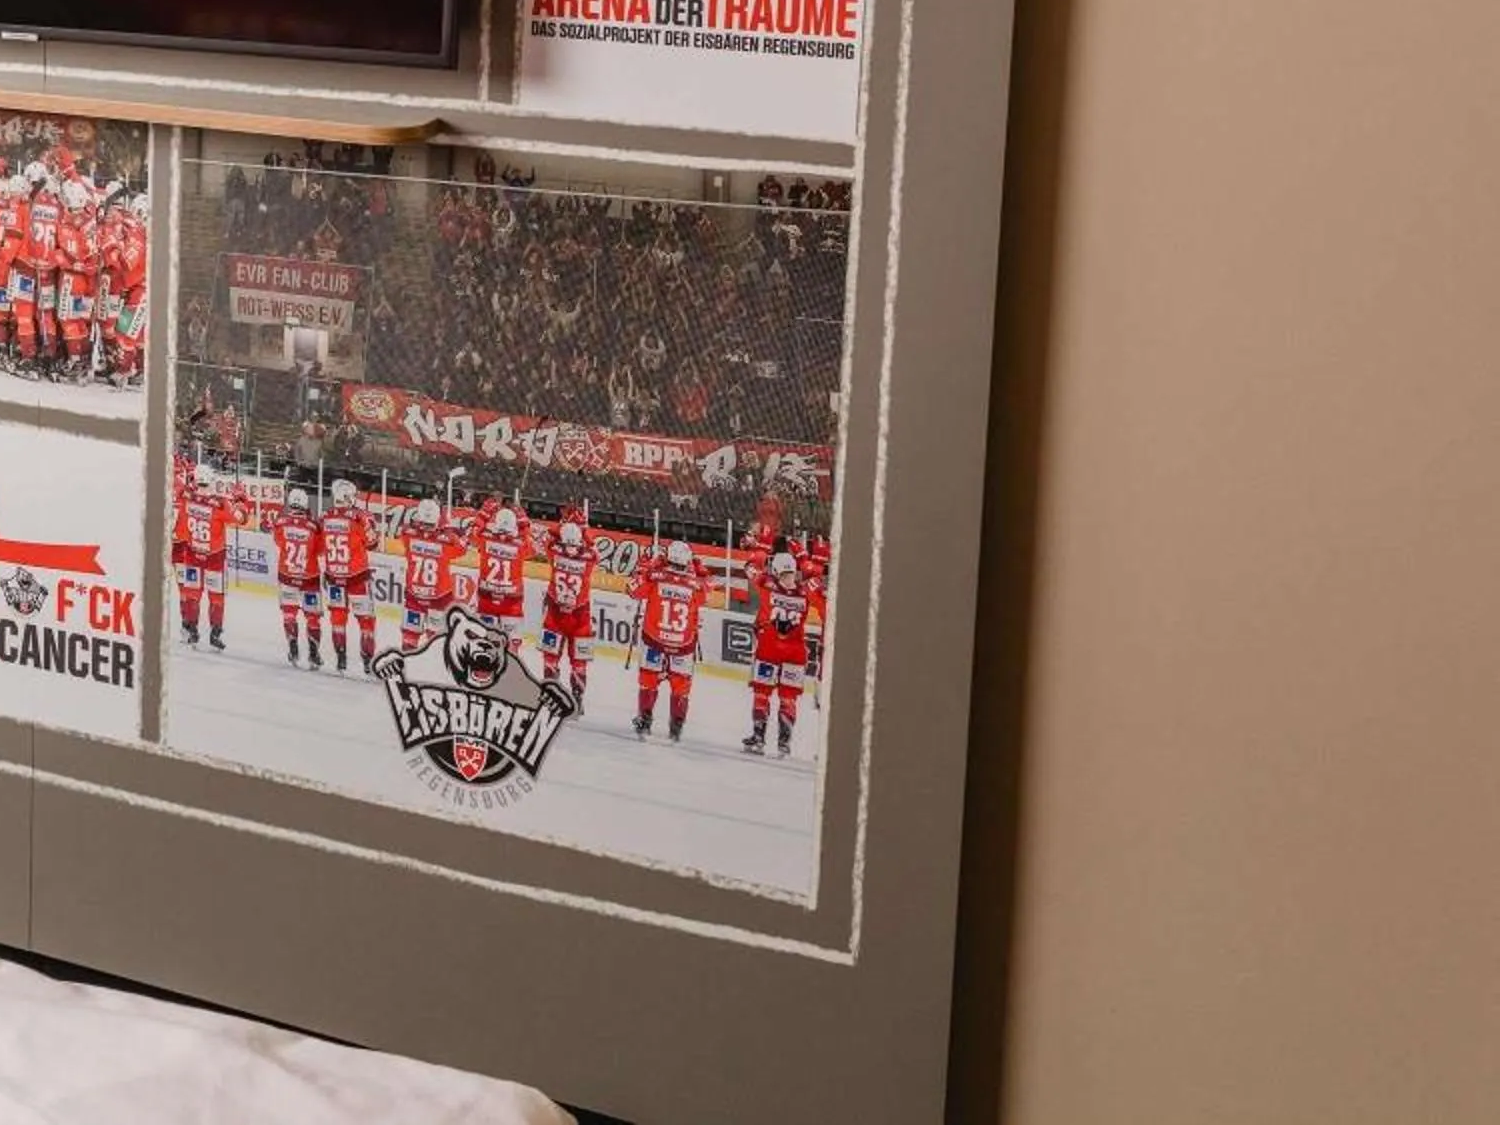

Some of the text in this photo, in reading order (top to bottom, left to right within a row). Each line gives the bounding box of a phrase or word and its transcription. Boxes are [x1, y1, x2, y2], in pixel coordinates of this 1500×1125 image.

[531, 20, 855, 60] DAS SOZIALPROJEKT DER EISBÄREN REGENSBURG
[236, 262, 350, 295] EVR FAN-CLUB
[407, 754, 534, 810] REGENSBURG
